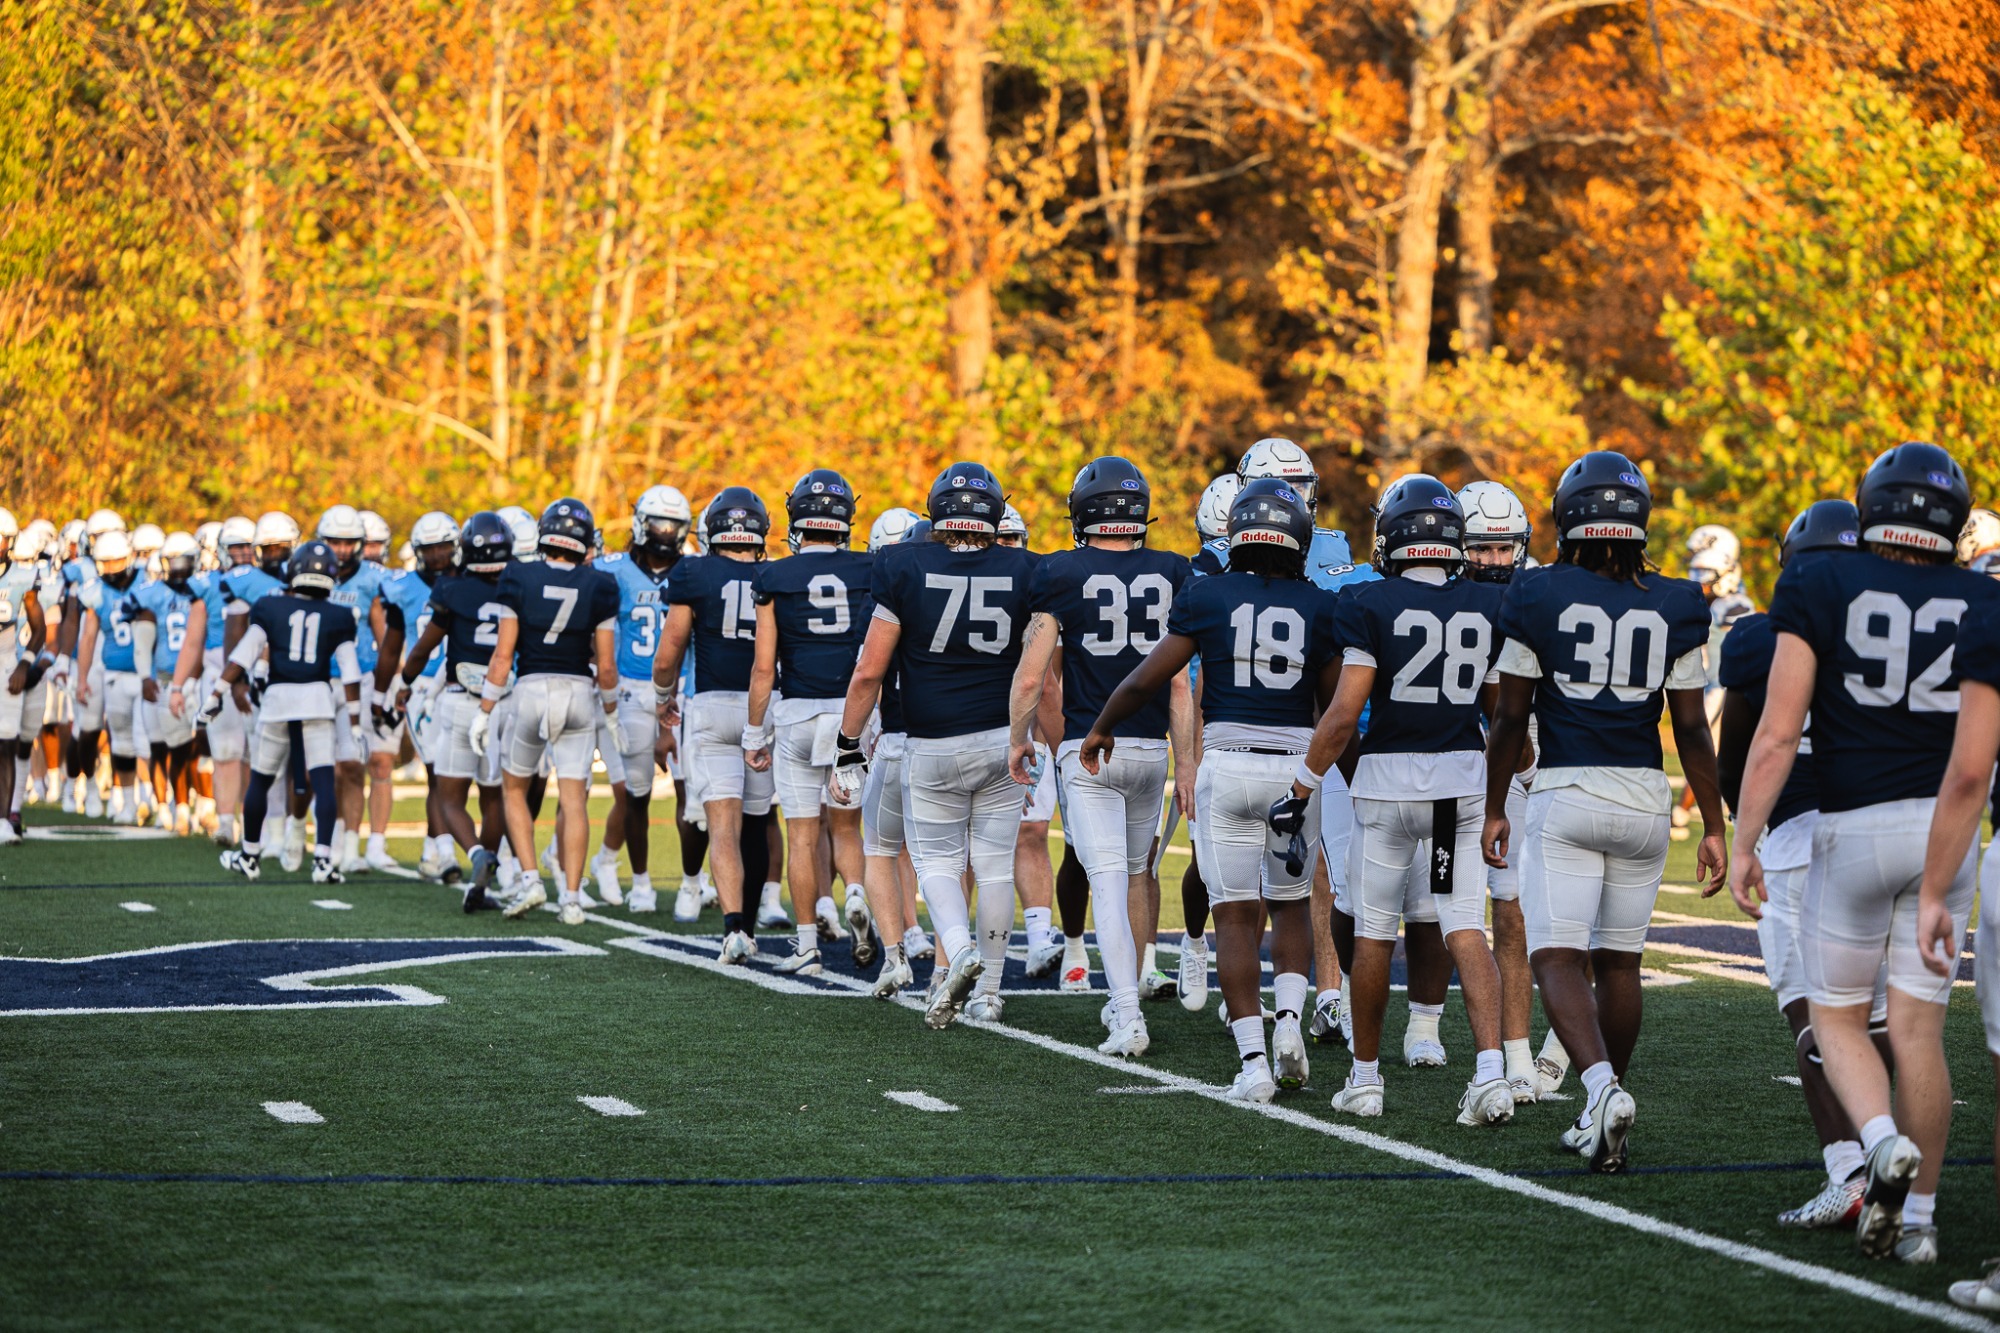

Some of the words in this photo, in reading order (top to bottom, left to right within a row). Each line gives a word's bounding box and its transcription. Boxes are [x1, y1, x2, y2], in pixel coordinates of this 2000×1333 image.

[806, 519, 841, 530] Riddell
[946, 520, 984, 531] Riddell
[1116, 498, 1126, 506] 33
[721, 533, 754, 542] Riddell
[1099, 525, 1139, 533] Riddell
[1241, 532, 1285, 544] Riddell
[1407, 547, 1451, 557] Riddell
[1585, 526, 1633, 538] Riddell
[1883, 529, 1939, 549] Riddell
[543, 585, 579, 644] 7
[807, 574, 851, 634] 9
[925, 573, 1013, 655] 75
[1082, 574, 1173, 656] 33
[289, 608, 321, 664] 11
[631, 605, 668, 657] 3
[1230, 602, 1306, 690] 18
[1390, 609, 1492, 705] 28
[1553, 603, 1668, 702] 30
[1843, 590, 1968, 712] 92
